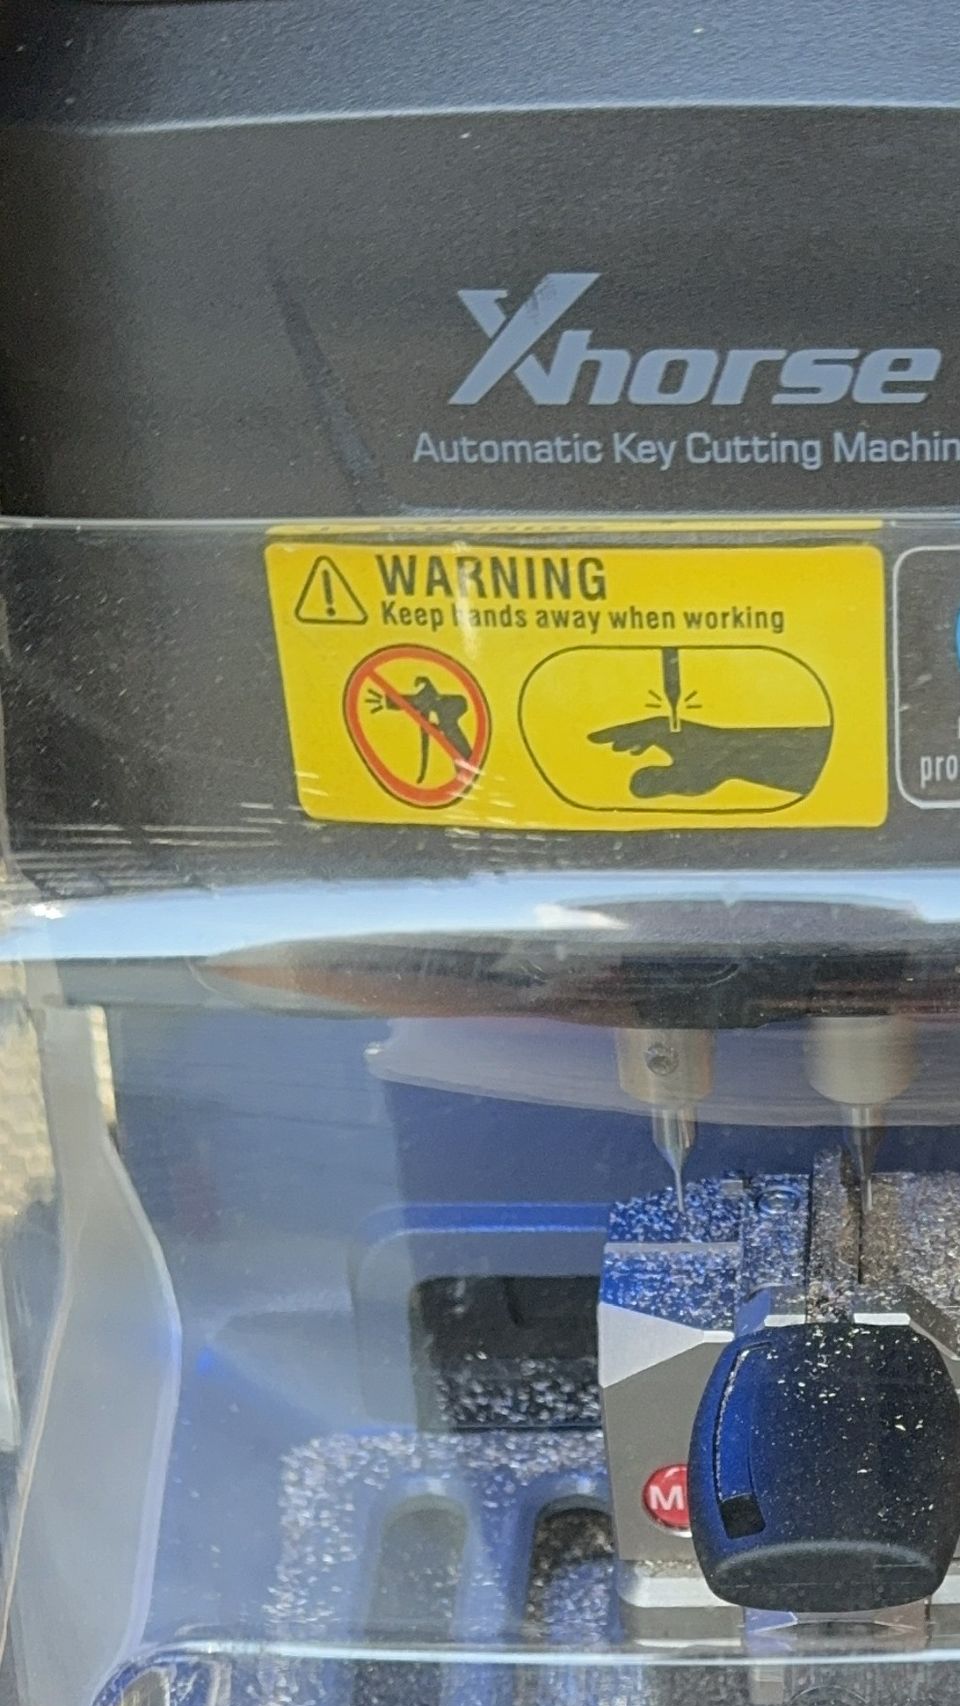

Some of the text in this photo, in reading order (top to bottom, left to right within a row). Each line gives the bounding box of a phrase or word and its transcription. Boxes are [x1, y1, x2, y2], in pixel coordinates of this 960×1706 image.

[447, 272, 943, 405] Xhorse
[412, 431, 602, 464] Automatic
[612, 431, 678, 471] Key
[685, 431, 823, 471] Cutting
[375, 554, 608, 601] WARNING
[381, 600, 444, 632] Keep
[536, 608, 601, 634] away
[609, 605, 676, 630] when
[683, 606, 785, 634] working
[649, 1485, 685, 1511] M
